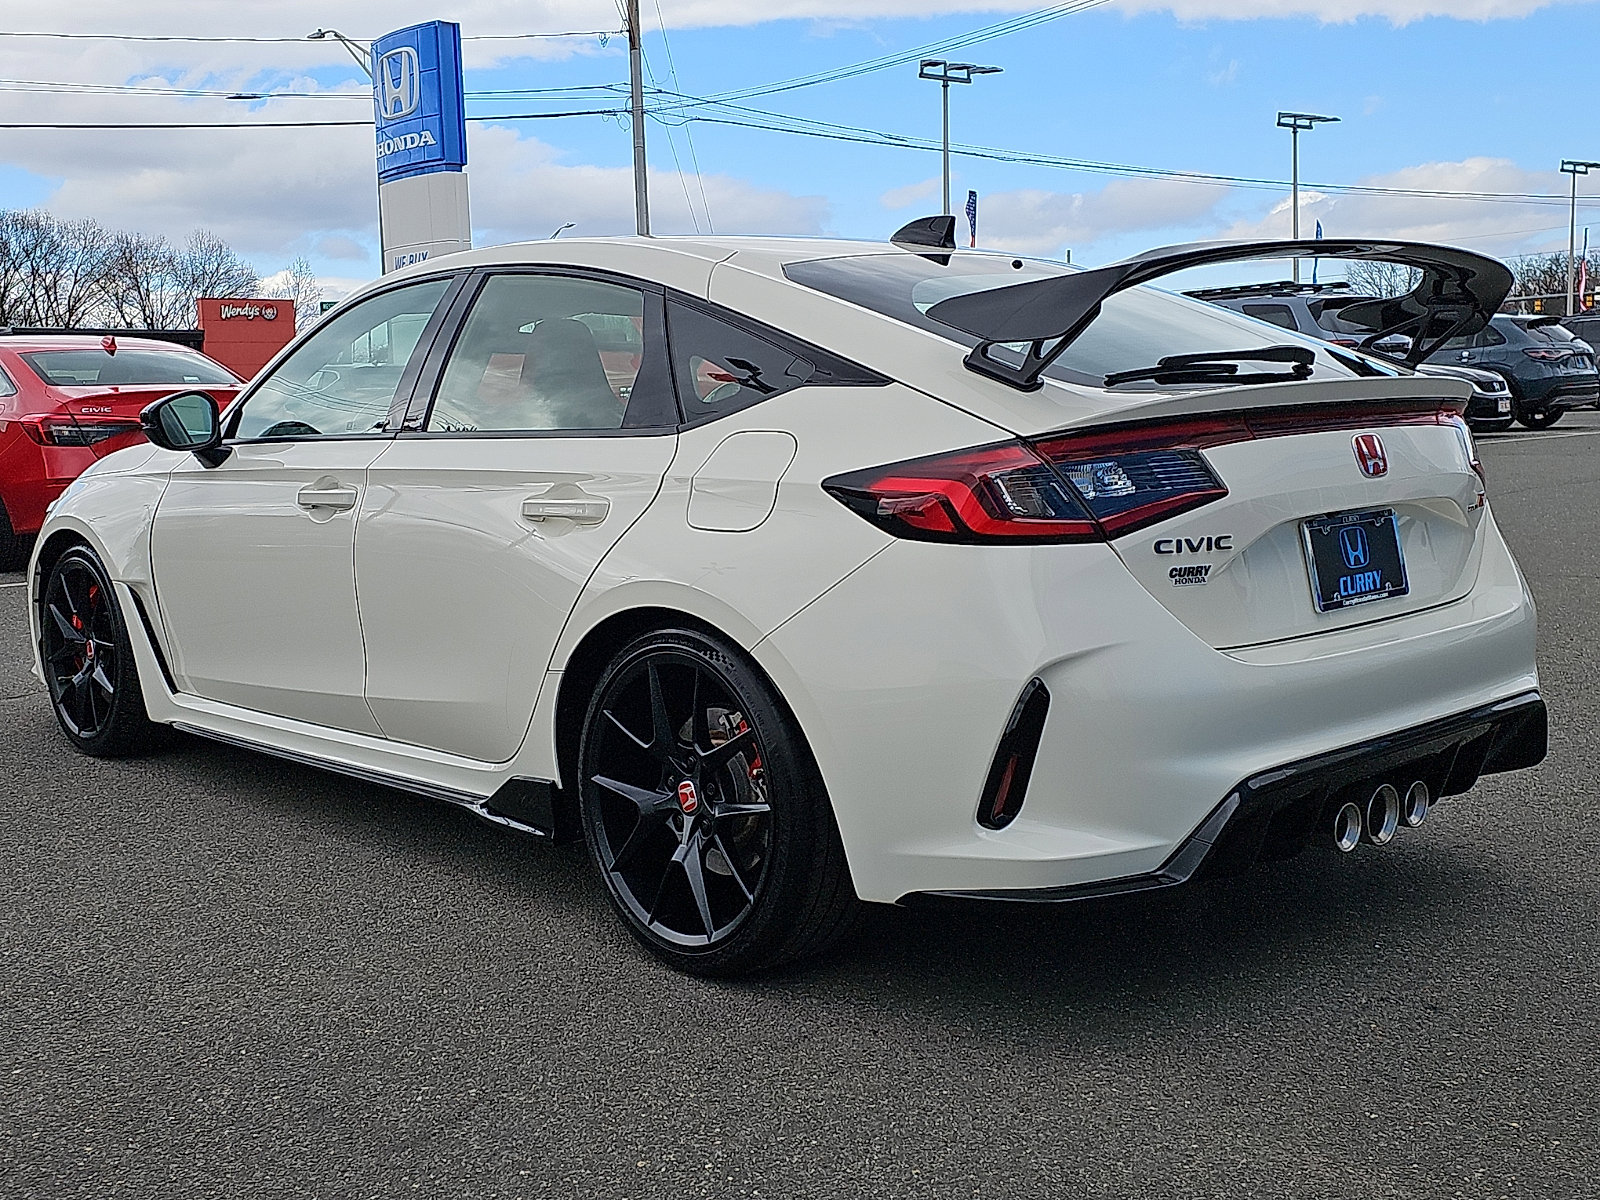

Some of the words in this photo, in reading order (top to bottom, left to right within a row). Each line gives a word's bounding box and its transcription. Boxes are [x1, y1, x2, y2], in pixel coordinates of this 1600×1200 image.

[376, 130, 437, 159] HONDA
[220, 303, 261, 320] Wendy's
[1153, 535, 1233, 555] CIVIC
[1169, 564, 1212, 579] CURRY
[1174, 576, 1207, 585] HONDA
[1339, 569, 1382, 597] CURRY
